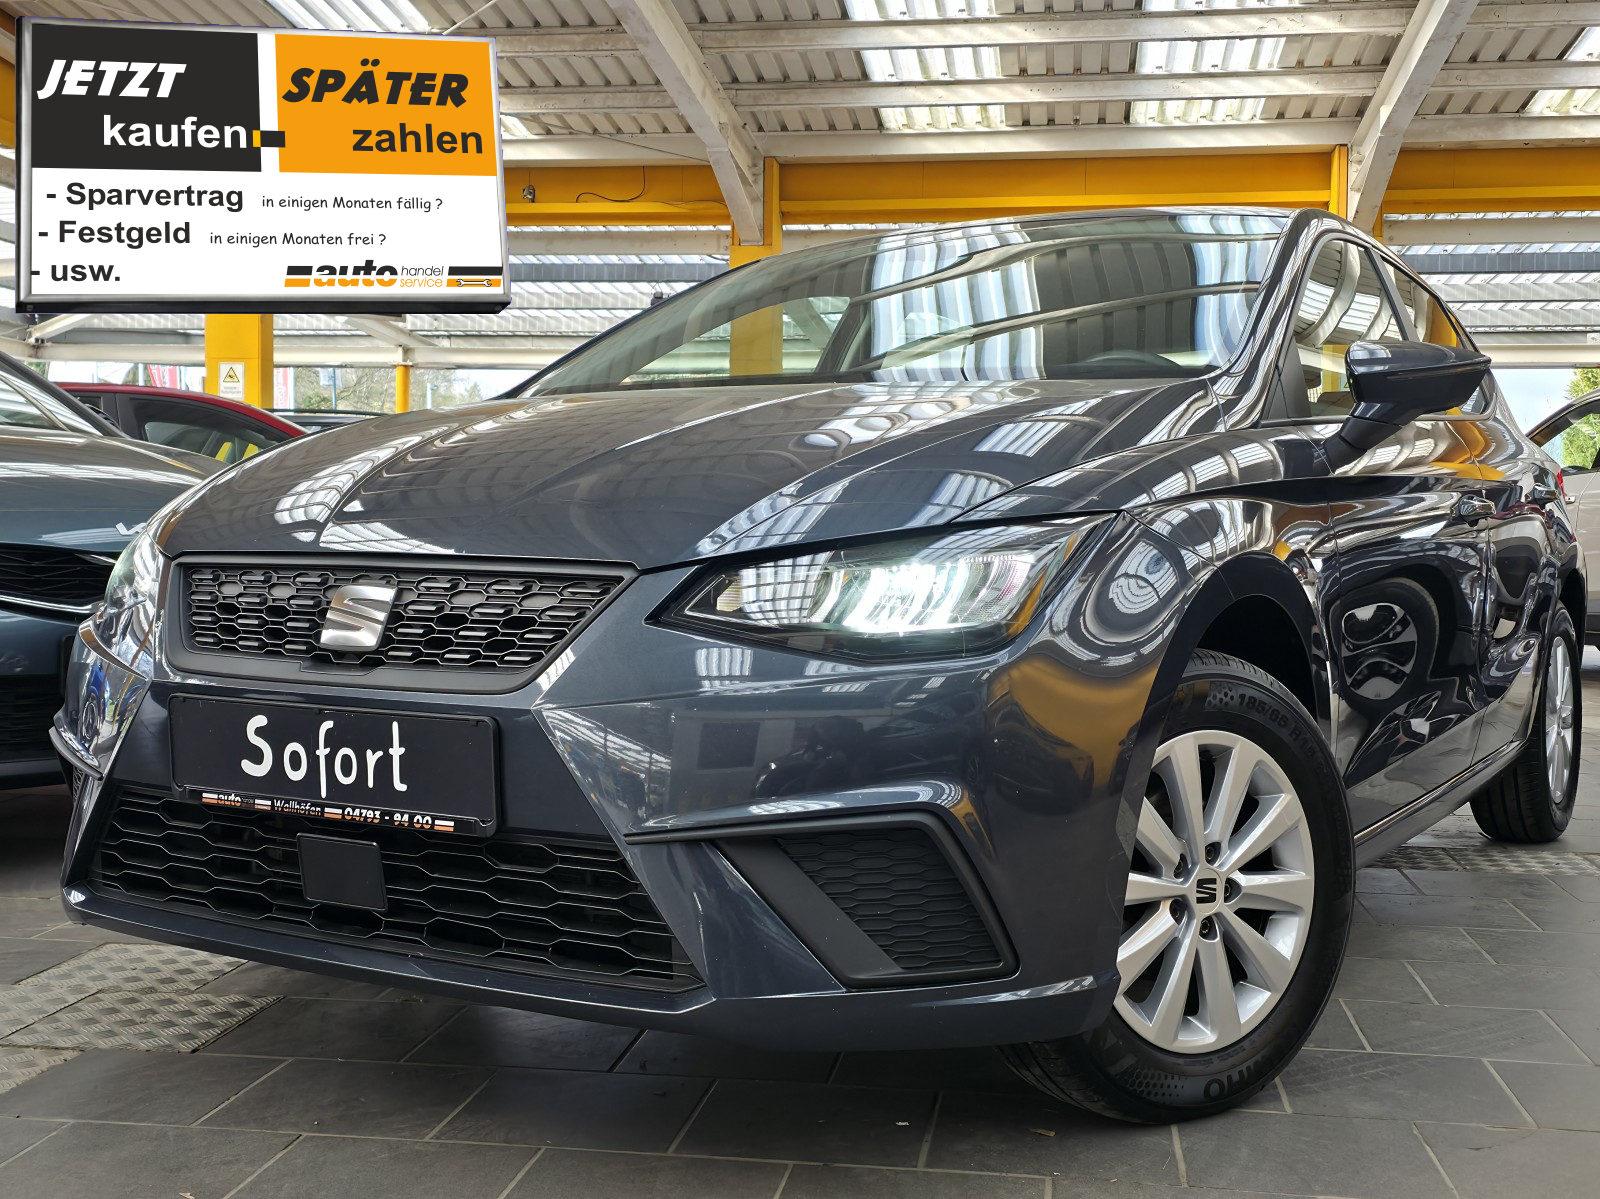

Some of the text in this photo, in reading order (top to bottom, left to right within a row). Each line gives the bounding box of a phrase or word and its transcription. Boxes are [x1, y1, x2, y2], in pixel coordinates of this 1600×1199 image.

[240, 713, 408, 799] Sofort
[344, 806, 381, 825] 04793
[393, 812, 410, 828] 94
[413, 814, 433, 830] 00
